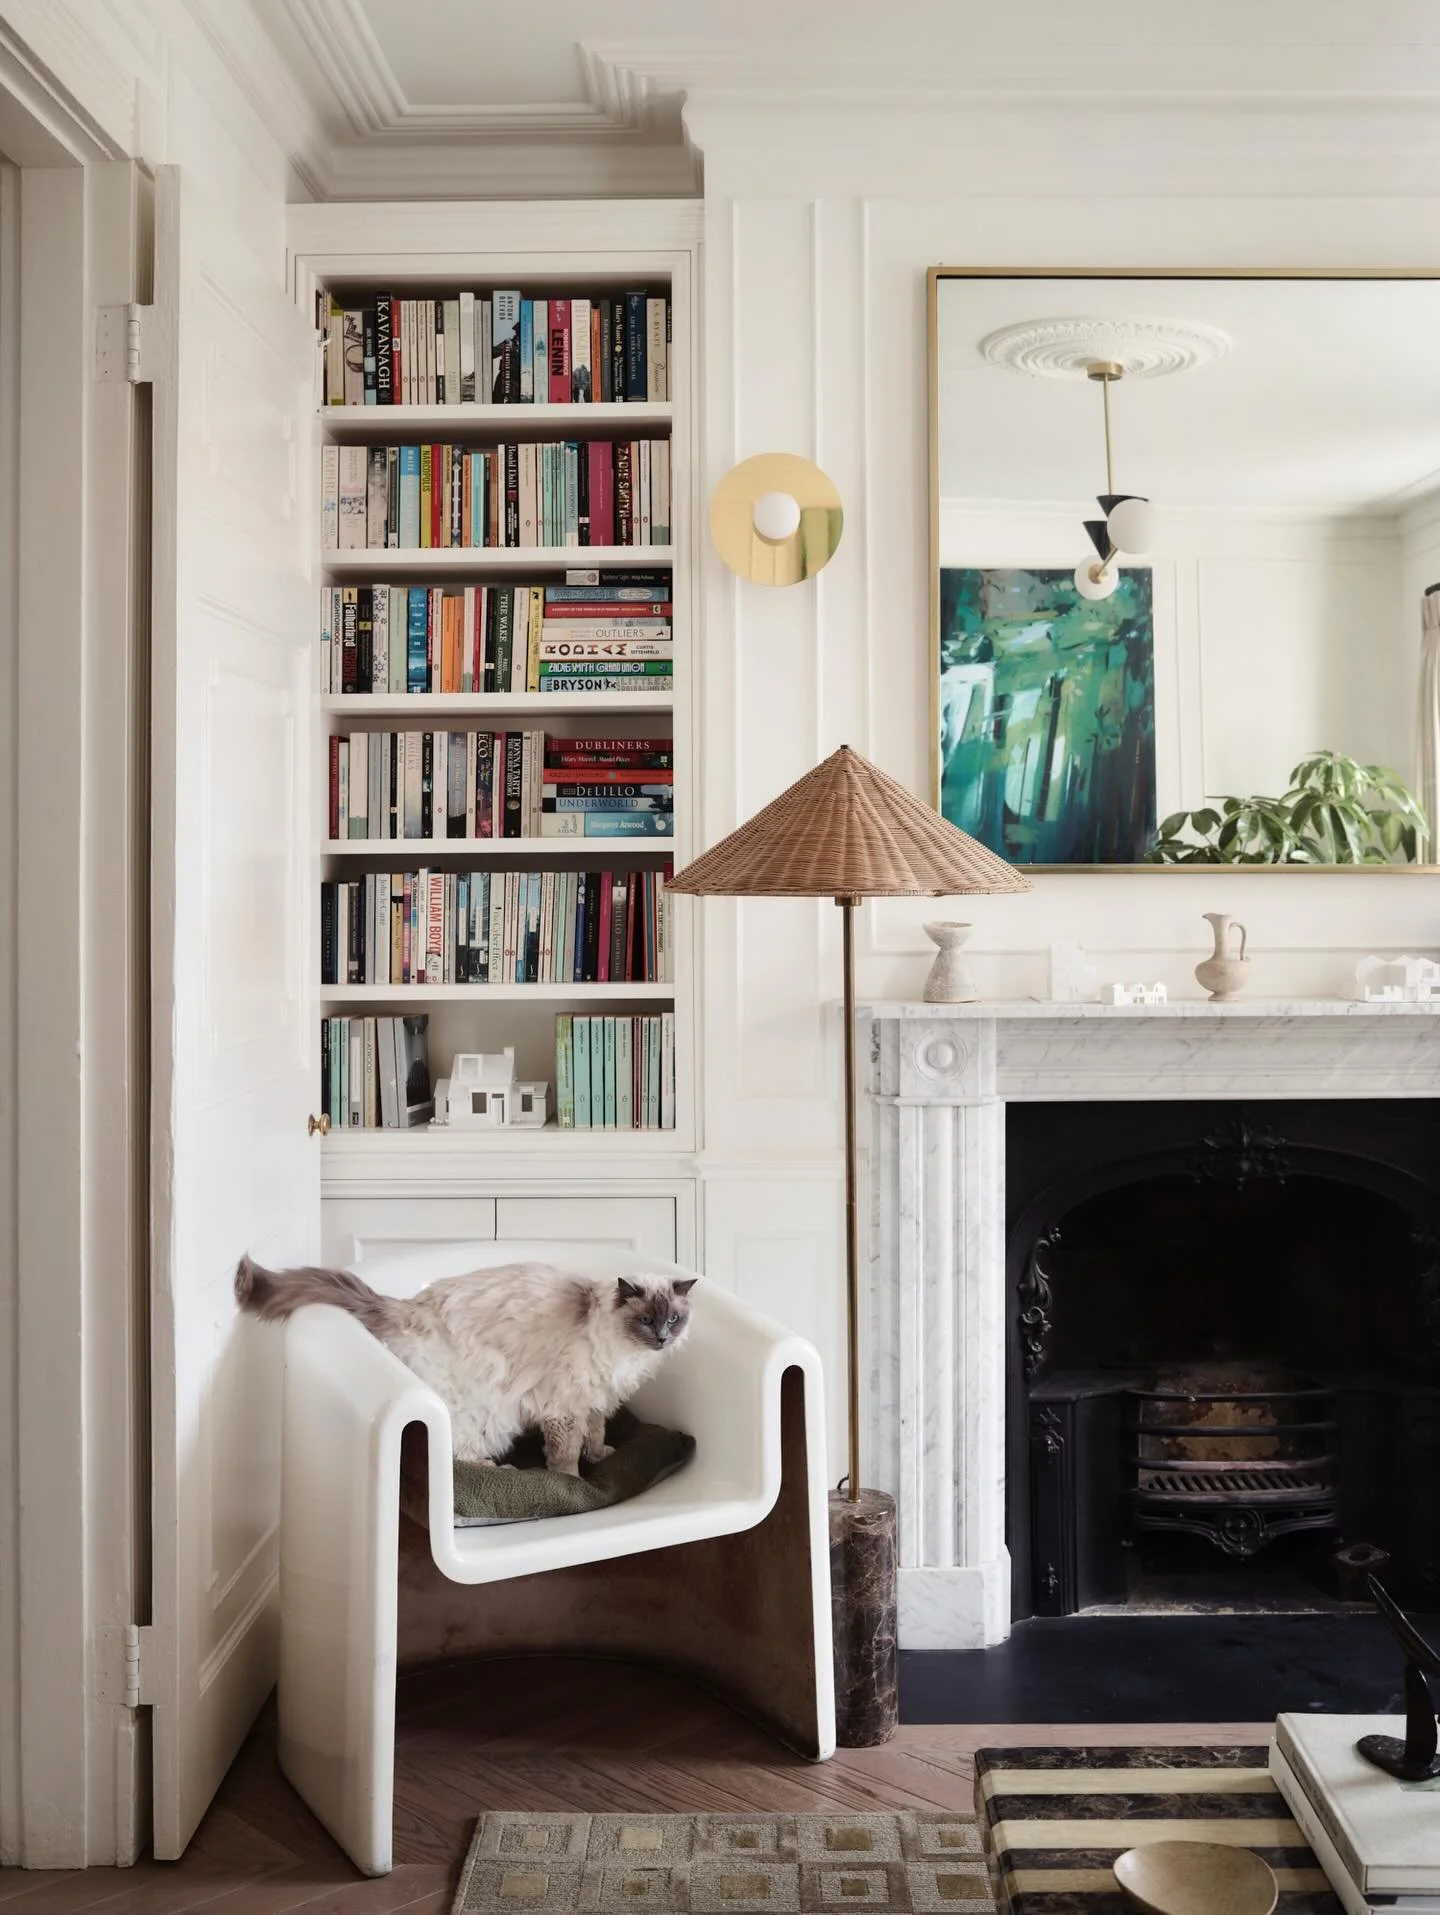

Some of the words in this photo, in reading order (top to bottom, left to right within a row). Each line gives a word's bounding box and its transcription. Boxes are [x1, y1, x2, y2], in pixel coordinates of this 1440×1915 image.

[377, 301, 390, 389] KAVANAGH
[552, 328, 563, 376] LENIN
[508, 445, 517, 467] Roald
[617, 447, 629, 479] ZADIE
[422, 450, 430, 492] NARCOPOLIS
[508, 469, 517, 488] Dahl
[618, 481, 629, 518] SMITH
[500, 594, 509, 615] THE
[344, 604, 357, 647] Fatherland
[499, 615, 507, 642] WAKE
[595, 629, 645, 638] OUTLIERS
[545, 643, 627, 656] RODHAM
[554, 679, 602, 691] BRYSON
[478, 733, 488, 758] ECO
[513, 738, 521, 767] DONNA
[575, 741, 650, 750] DUBLINERS
[512, 768, 520, 797] TARTT
[559, 799, 639, 808] UNDERWORLD
[429, 876, 443, 922] WILLIAM
[429, 926, 442, 954] BOYD
